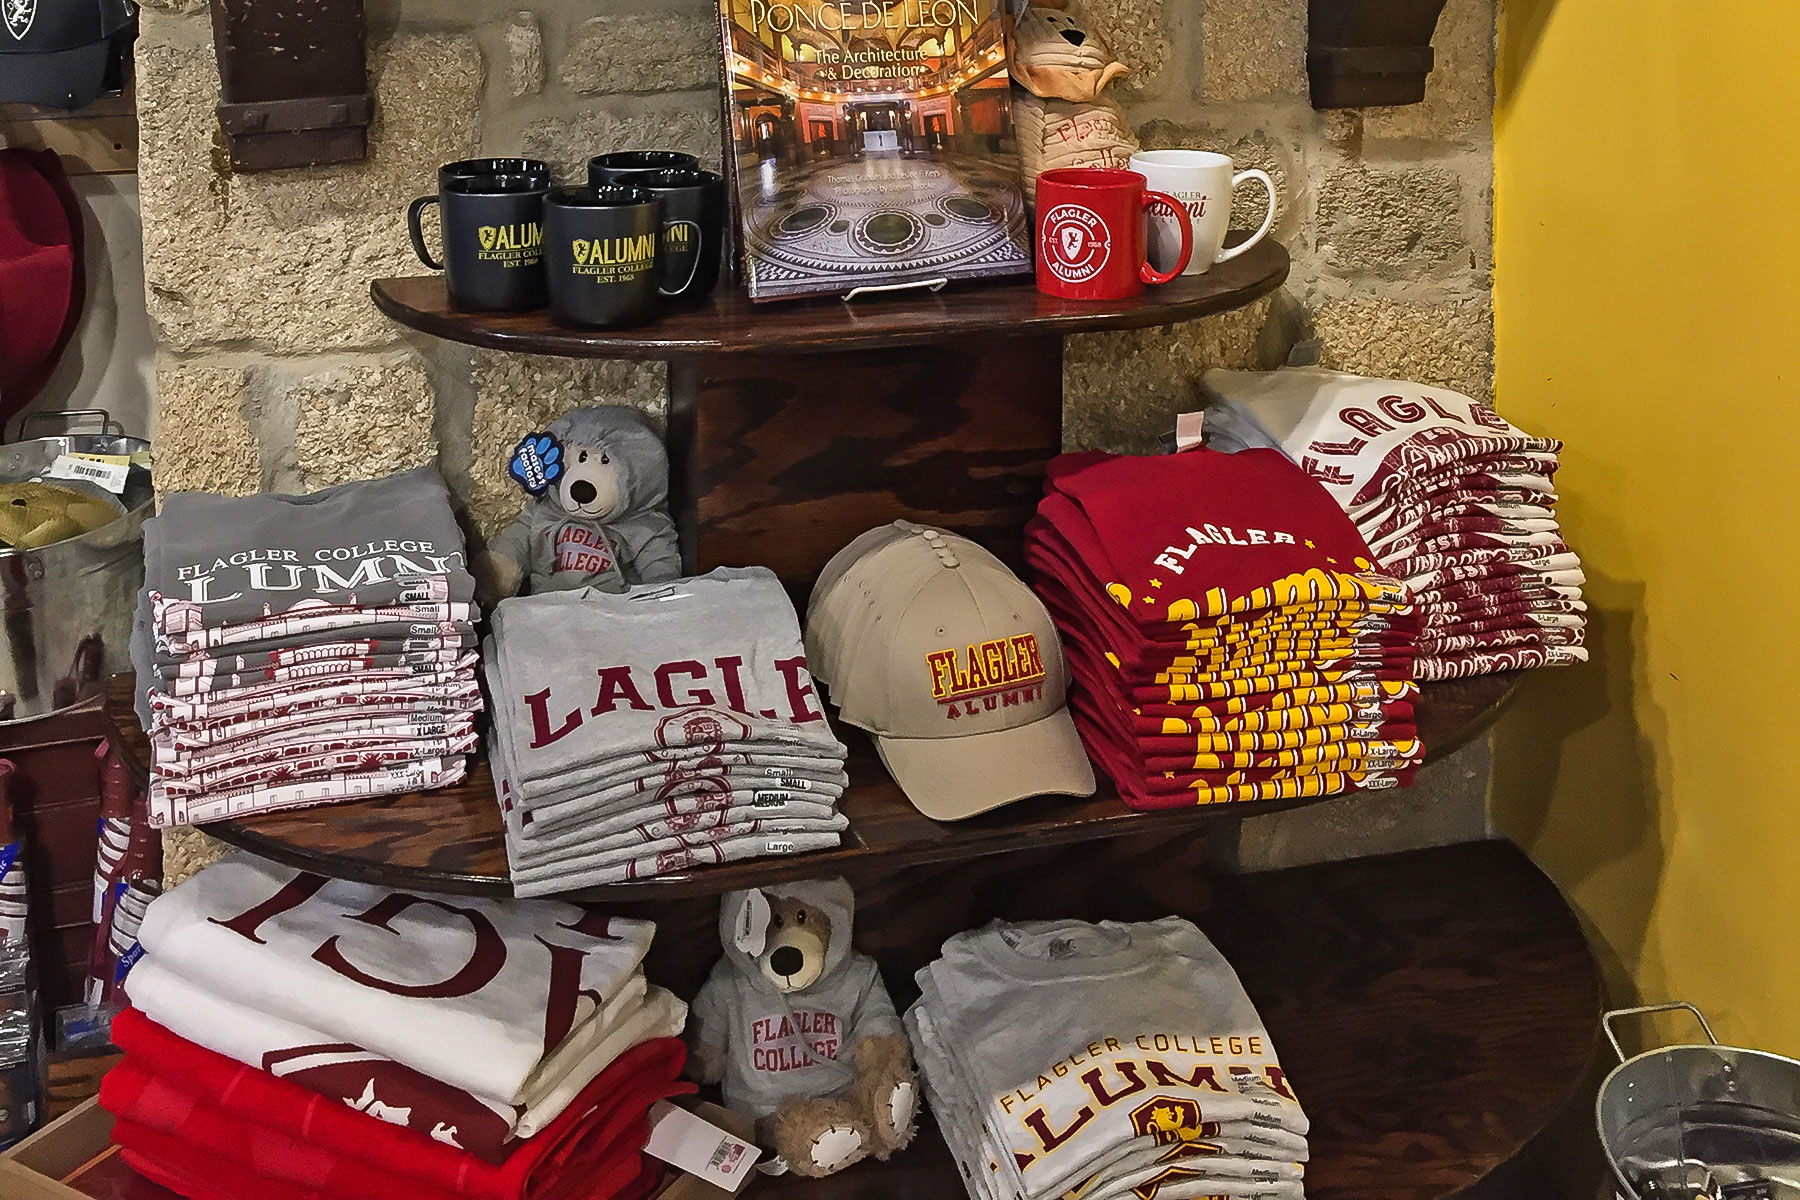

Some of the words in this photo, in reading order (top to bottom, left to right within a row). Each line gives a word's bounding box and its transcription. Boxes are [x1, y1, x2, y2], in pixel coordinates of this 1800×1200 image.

[750, 0, 856, 33] PONCE
[863, 1, 899, 29] DE
[814, 49, 840, 64] The
[843, 47, 928, 64] Architecture
[827, 67, 838, 80] &
[842, 64, 920, 79] Decoration
[1051, 209, 1097, 227] FLAGLER
[590, 233, 655, 264] ALUMNI
[573, 266, 615, 274] FLAGLER
[618, 259, 654, 273] COLLEGE
[1052, 262, 1094, 278] ALUMNI
[619, 274, 634, 282] 1968
[519, 447, 537, 488] factory
[528, 444, 546, 487] mascot
[1154, 523, 1296, 575] FLAGLER
[1427, 534, 1461, 550] EST
[177, 549, 300, 581] FLAGLER
[315, 540, 436, 561] COLLEGE
[1453, 565, 1487, 580] EST
[411, 626, 436, 634] Small
[413, 665, 437, 673] SMALL
[926, 632, 1045, 699] FLAGLER
[946, 686, 1042, 720] ALUMNI
[1359, 711, 1381, 719] Large
[417, 726, 421, 736] X
[423, 725, 446, 734] LARGE
[1371, 748, 1397, 756] X-Large
[1367, 760, 1394, 768] XX-Large
[781, 778, 806, 789] SMALL
[1368, 780, 1397, 788] XXX-Large
[767, 843, 793, 852] Large
[1000, 1037, 1121, 1114] FLAGLER
[1136, 1034, 1262, 1055] COLLEGE
[1254, 1112, 1281, 1123] Medium
